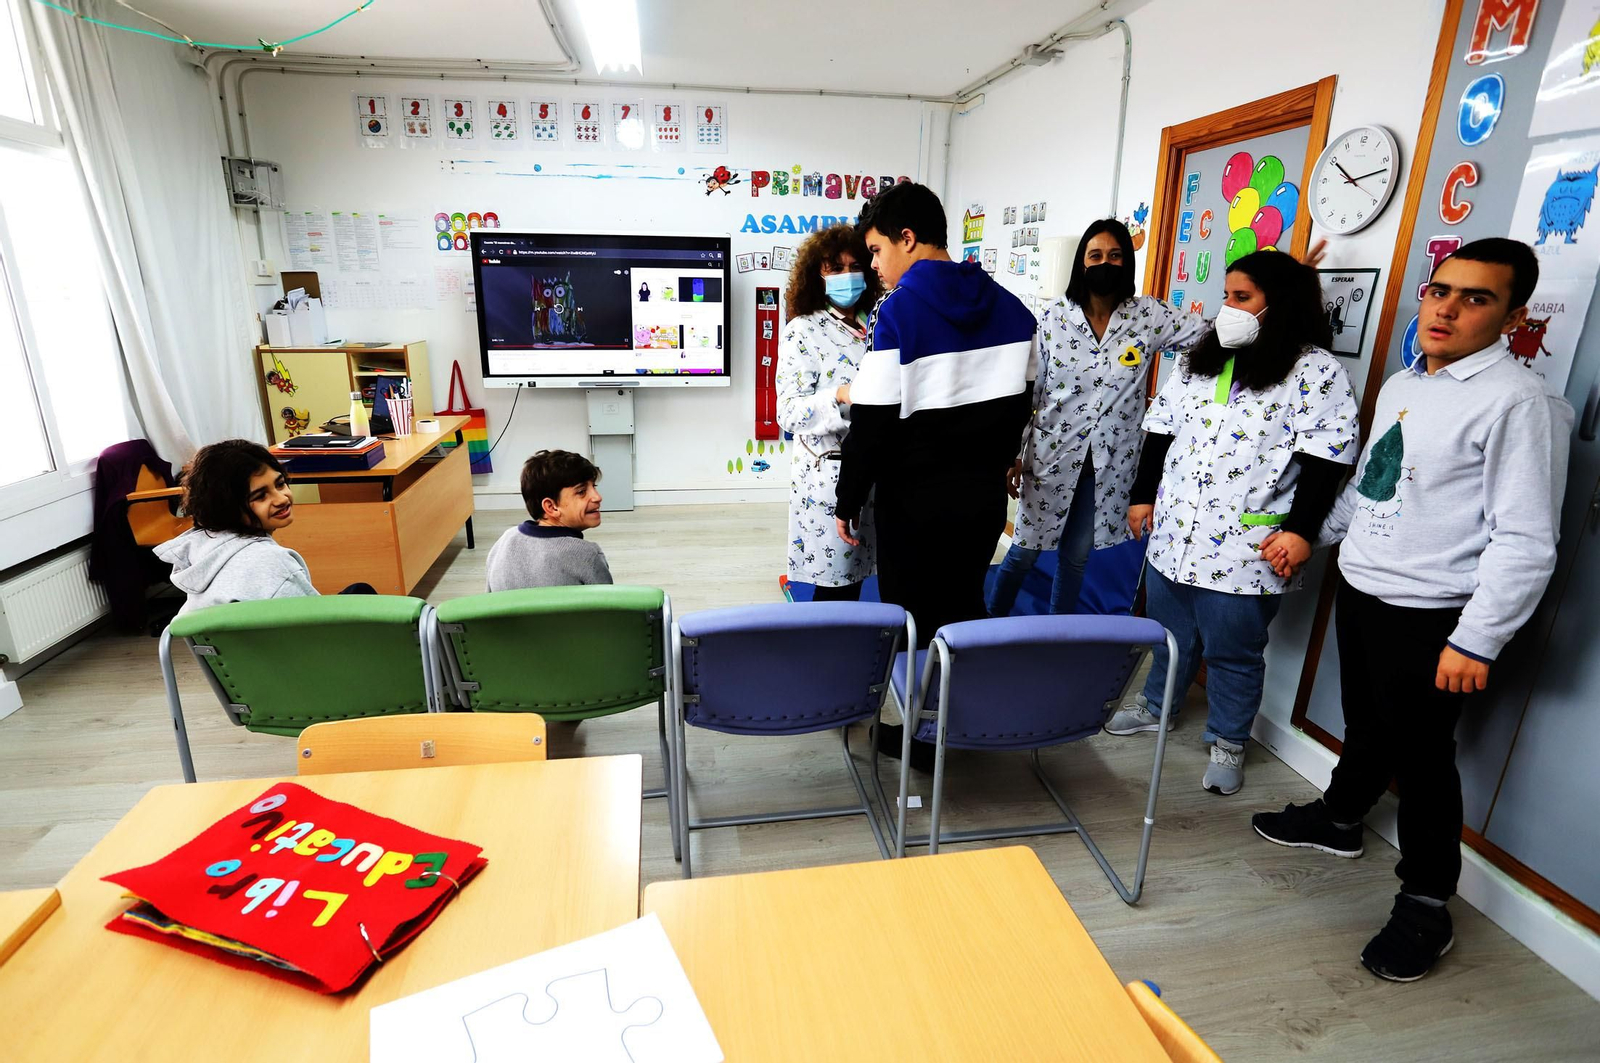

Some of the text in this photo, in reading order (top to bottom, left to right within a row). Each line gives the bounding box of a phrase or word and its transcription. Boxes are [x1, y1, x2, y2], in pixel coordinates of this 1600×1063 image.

[368, 98, 714, 124] 1 2 3 4 5 6 7 8 9
[1360, 135, 1369, 144] 12
[1382, 155, 1390, 164] 2
[1321, 177, 1328, 185] 9
[1320, 197, 1327, 205] 8
[1372, 198, 1378, 206] 4
[1356, 211, 1363, 220] 5
[1340, 217, 1346, 225] 6
[1532, 302, 1565, 313] RABIA
[241, 794, 448, 889] Educativo
[205, 859, 349, 927] Libro
